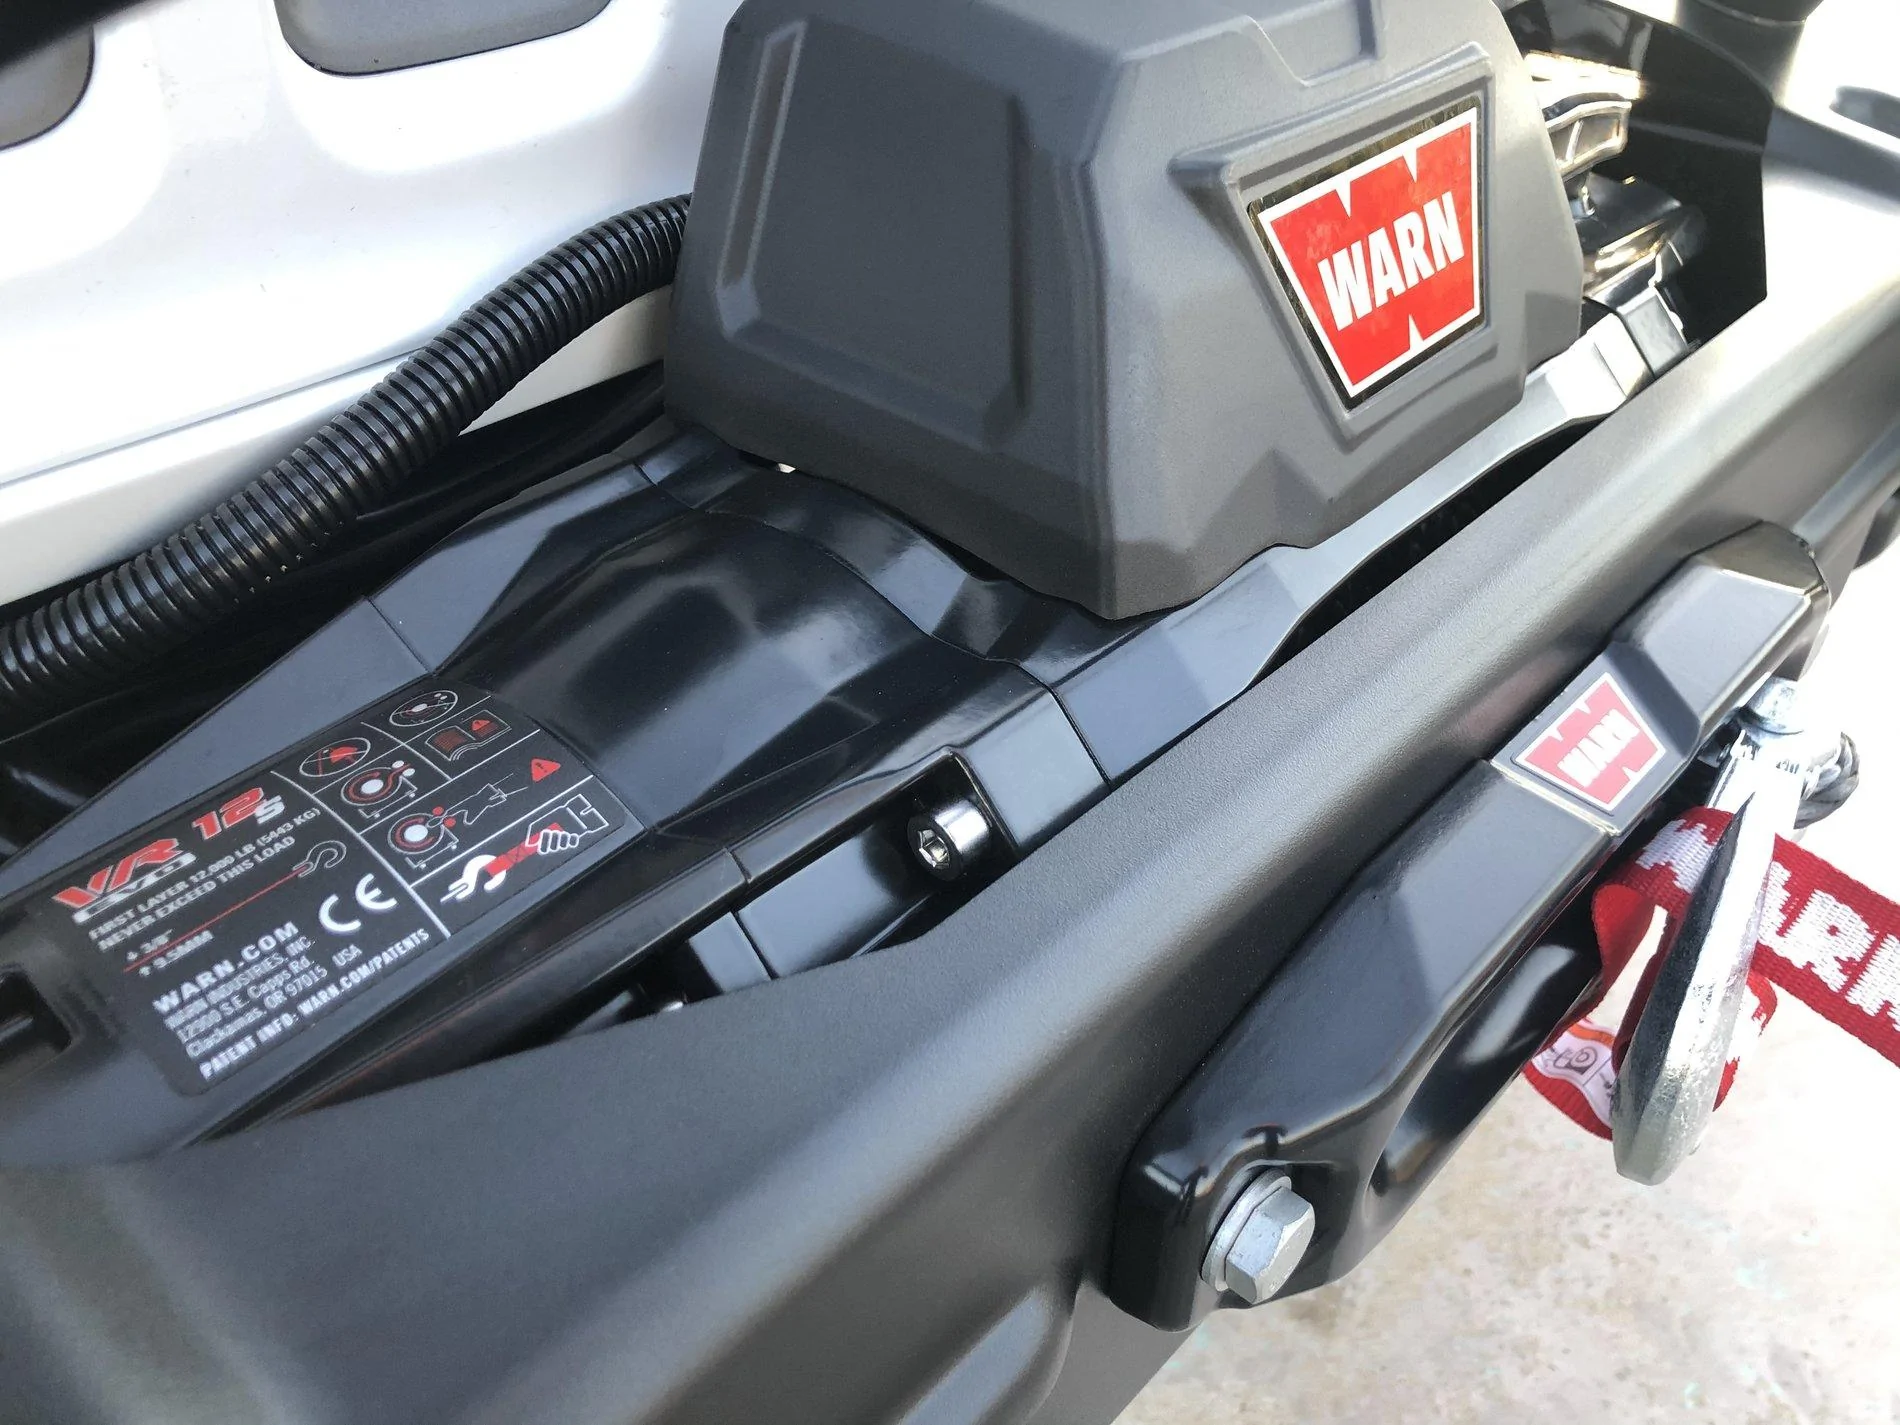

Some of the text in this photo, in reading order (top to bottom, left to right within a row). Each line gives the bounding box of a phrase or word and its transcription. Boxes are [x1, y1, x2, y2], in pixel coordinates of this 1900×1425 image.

[1317, 191, 1465, 331] WARN
[1557, 708, 1641, 788] WARN
[51, 838, 183, 909] VR
[88, 807, 321, 940] FIRST LAYER 12,000 LB (5443 KG)
[98, 835, 296, 950] NEVER EXCEED THIS LOAD
[318, 873, 398, 933] CE
[153, 921, 299, 1013] WARN.COM
[247, 969, 292, 1000] Capps
[288, 955, 315, 975] Rd.
[263, 989, 288, 1009] OR
[284, 965, 328, 997] 97015
[332, 944, 363, 967] USA
[285, 935, 316, 957] INC.
[199, 1035, 257, 1079] PATENT
[297, 928, 430, 1016] WARN.COM/PATENTS
